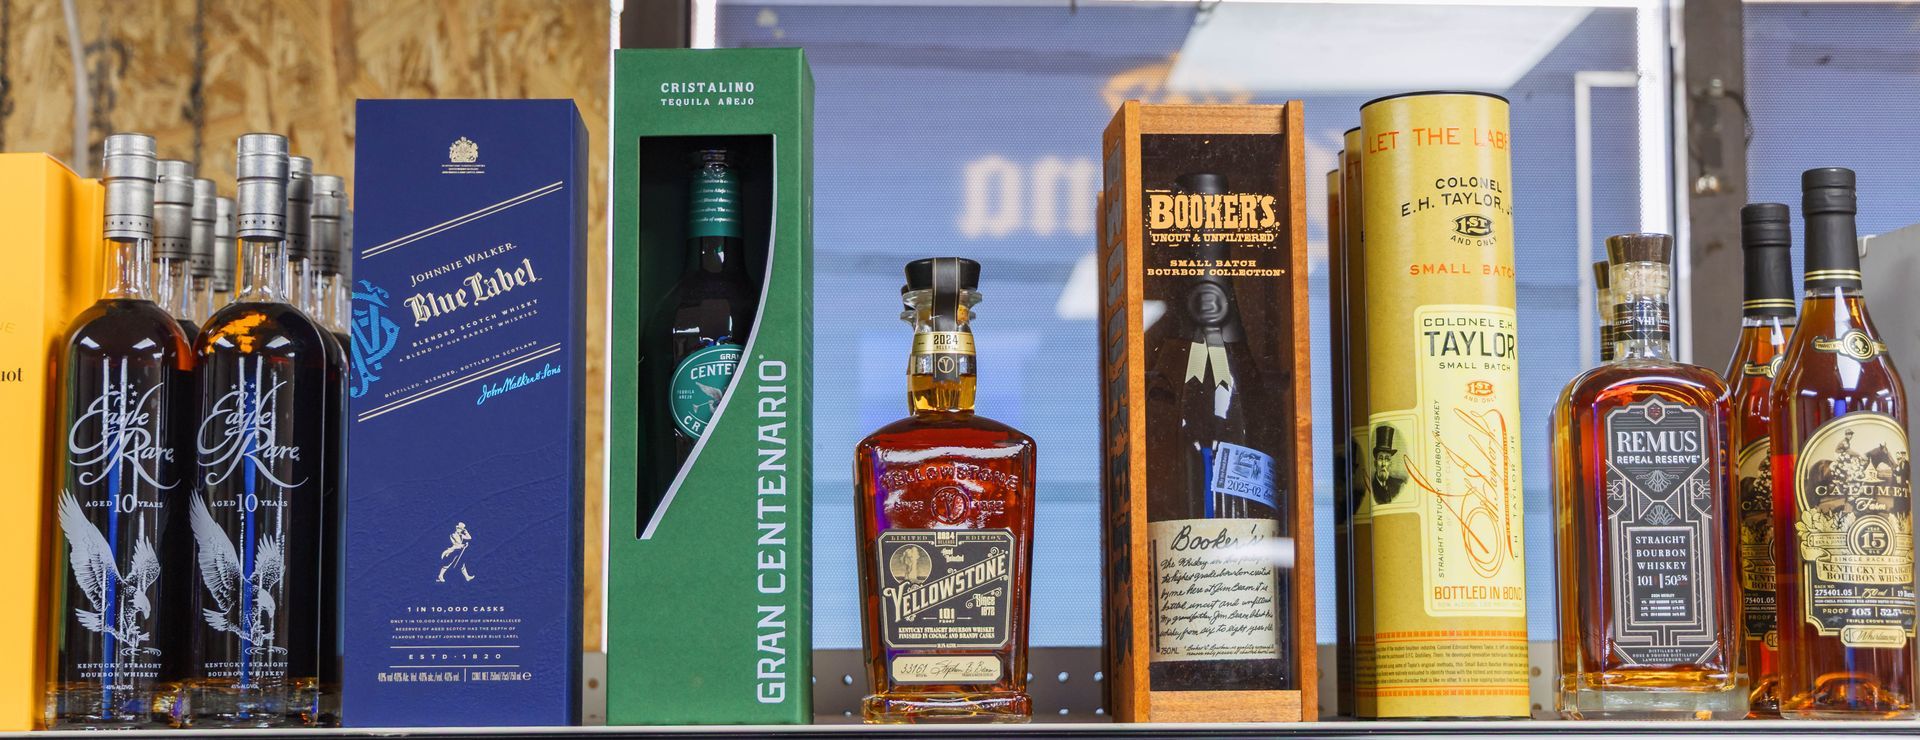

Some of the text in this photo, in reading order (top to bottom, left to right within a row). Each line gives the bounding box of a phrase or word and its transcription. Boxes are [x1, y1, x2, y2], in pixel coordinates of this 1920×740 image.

[660, 82, 755, 93] CRISTALINO
[660, 97, 755, 107] TEQUILA AÑEJO
[1368, 131, 1400, 154] LET
[1412, 127, 1462, 146] THE
[1435, 176, 1502, 193] COLONEL
[1150, 194, 1276, 229] BOOKER'S
[1401, 196, 1435, 217] E.H.
[1151, 233, 1275, 242] UNCUT & UNFILTERED
[1450, 235, 1498, 247] AND ONLY
[410, 242, 514, 288] JOHNNIE WALKER
[1147, 268, 1205, 276] BOURBON
[1410, 263, 1471, 276] SMALL
[403, 257, 537, 328] Blue Label
[412, 298, 538, 348] BLENDED SCOTCH WHISKY
[1423, 317, 1495, 328] COLONEL
[406, 347, 433, 360] BLEND
[463, 325, 494, 339] RAREST
[498, 310, 538, 327] WHISKIES
[933, 334, 959, 345] 2024
[1424, 330, 1516, 360] TAYLOR
[460, 357, 490, 371] BOTTLED
[502, 340, 538, 356] SCOTLAND
[1439, 362, 1511, 371] SMALL BATCH
[69, 383, 164, 465] Eagle
[197, 380, 287, 466] Eagle
[1616, 430, 1697, 453] REMUS
[79, 426, 181, 490] Rare
[205, 427, 309, 489] Rare
[1616, 455, 1653, 464] REPEAL
[1226, 480, 1262, 498] 2025-02
[1815, 485, 1909, 498] CALUMET
[85, 500, 113, 508] AGED
[113, 493, 136, 513] 10
[211, 493, 288, 513] AGED 10 YEARS
[1854, 497, 1886, 511] Farm
[757, 360, 787, 704] GRAN CENTENARIO
[1635, 535, 1686, 544] STRAIGHT
[1860, 532, 1886, 548] 15
[1636, 549, 1687, 558] BOURBON
[1637, 561, 1687, 570] WHISKEY
[1822, 563, 1876, 574] KENTUCKY
[1637, 575, 1653, 586] 101
[1826, 572, 1875, 581] BOURBON
[883, 553, 1007, 623] YELLOWSTONE
[1434, 585, 1487, 600] BOTTLED
[1490, 586, 1500, 600] IN
[938, 608, 955, 620] 101
[124, 662, 163, 670] STRAIGHT
[249, 661, 289, 669] STRAIGHT
